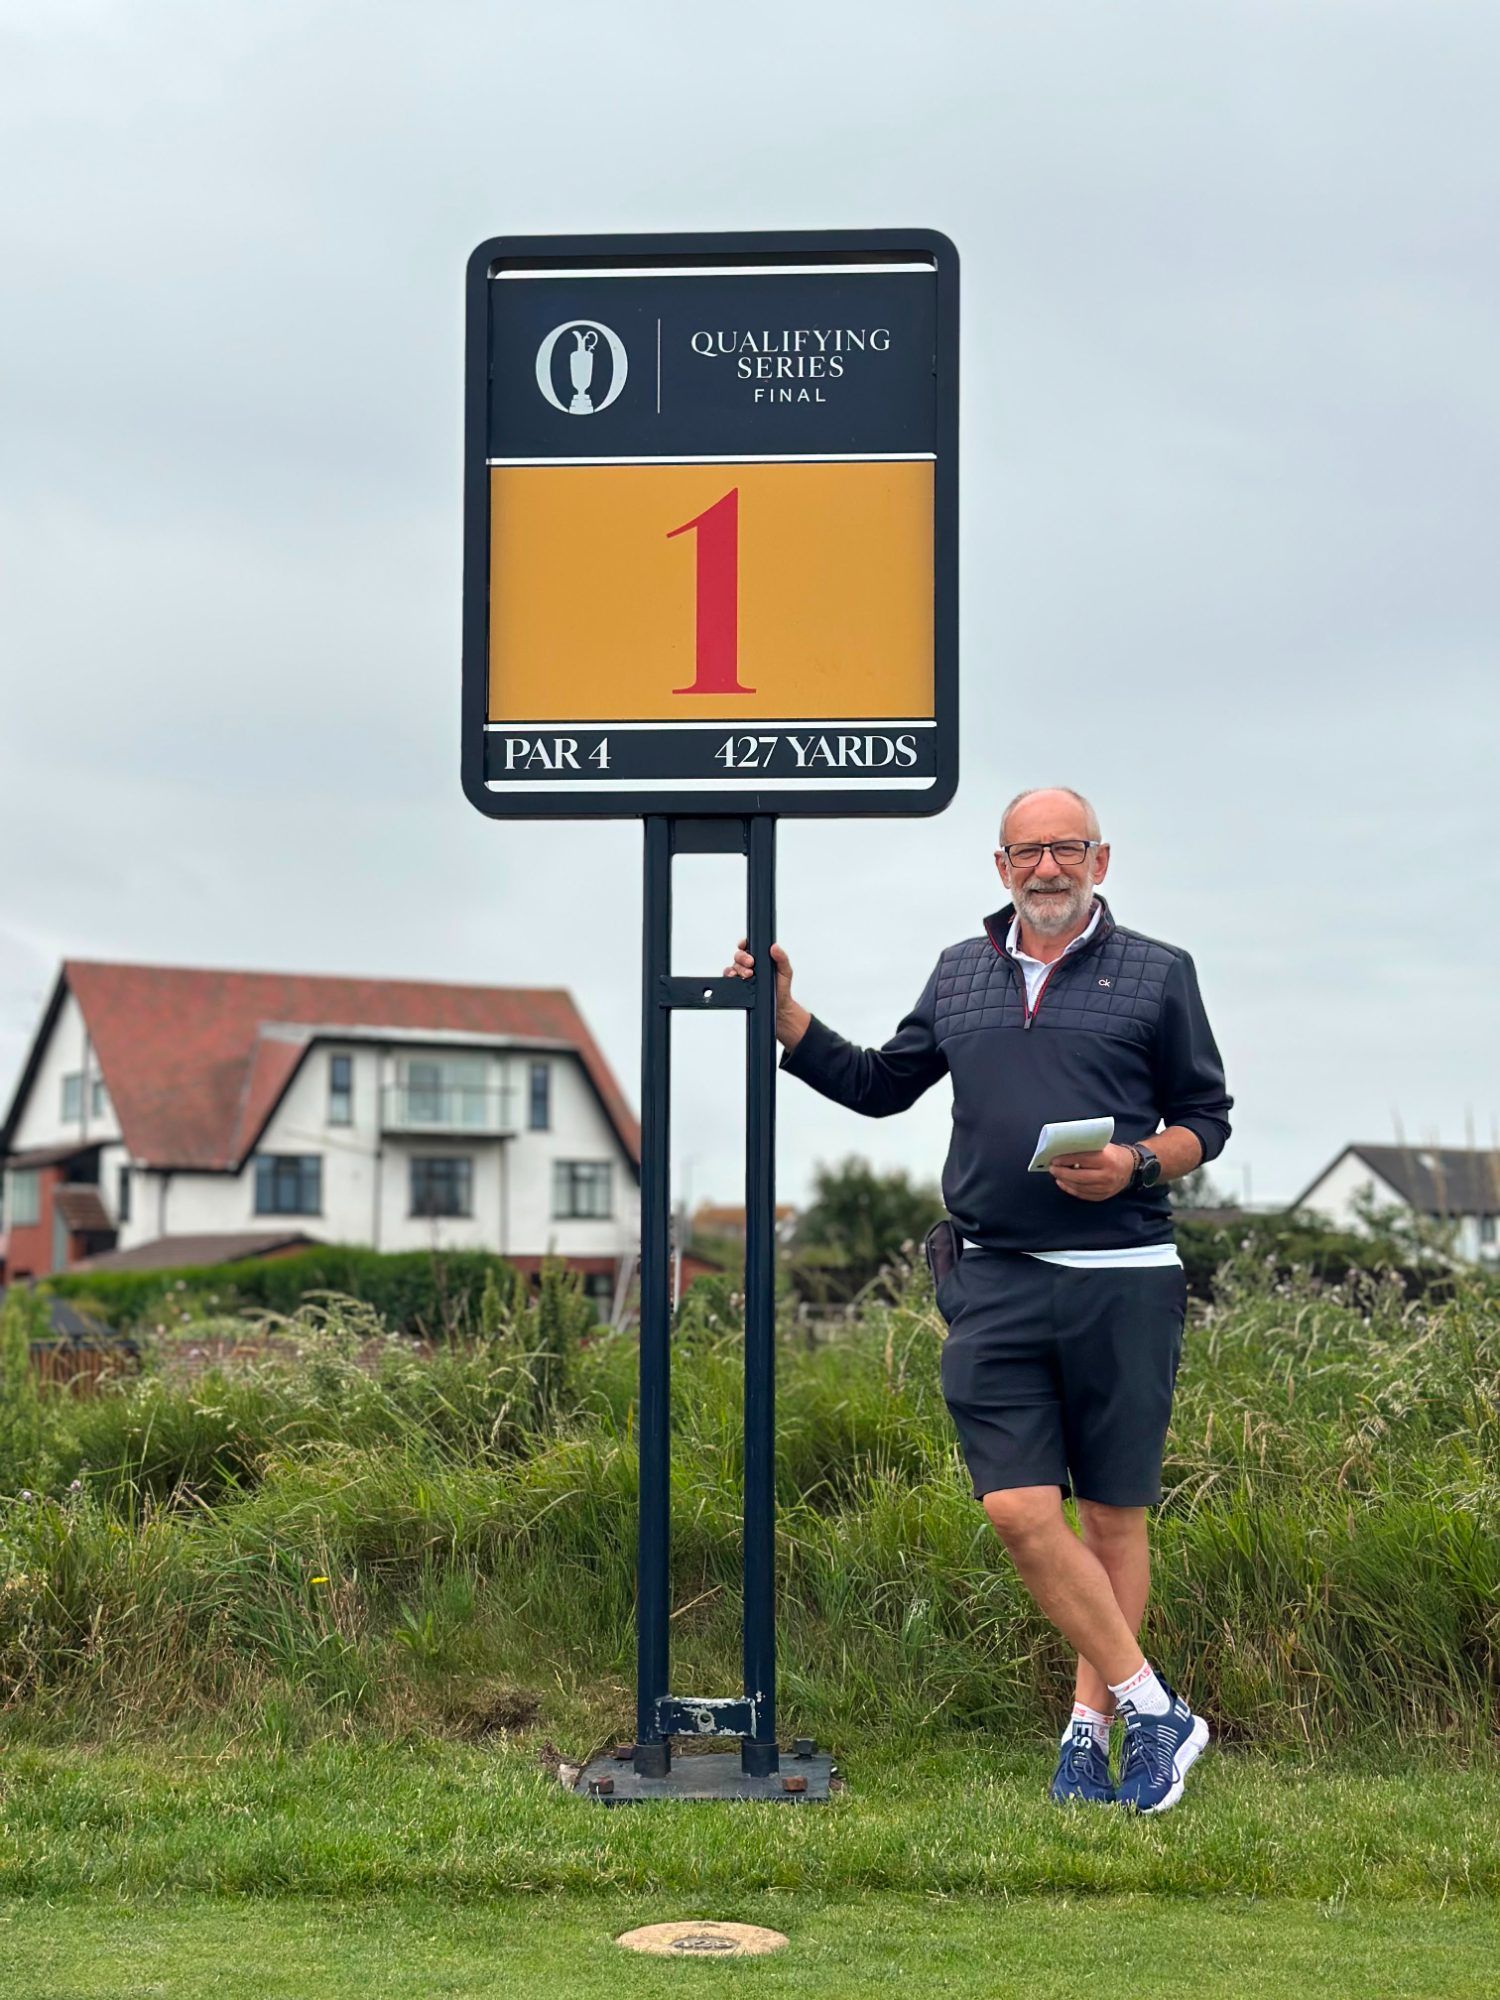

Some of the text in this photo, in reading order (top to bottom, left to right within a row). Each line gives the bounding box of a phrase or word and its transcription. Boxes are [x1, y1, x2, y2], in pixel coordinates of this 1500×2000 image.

[690, 328, 891, 358] QUALIFYING
[737, 355, 844, 379] SERIES
[754, 387, 827, 403] FINAL
[667, 487, 757, 695] 1
[504, 737, 612, 770] PAR 4
[714, 734, 918, 768] 427 YARDS
